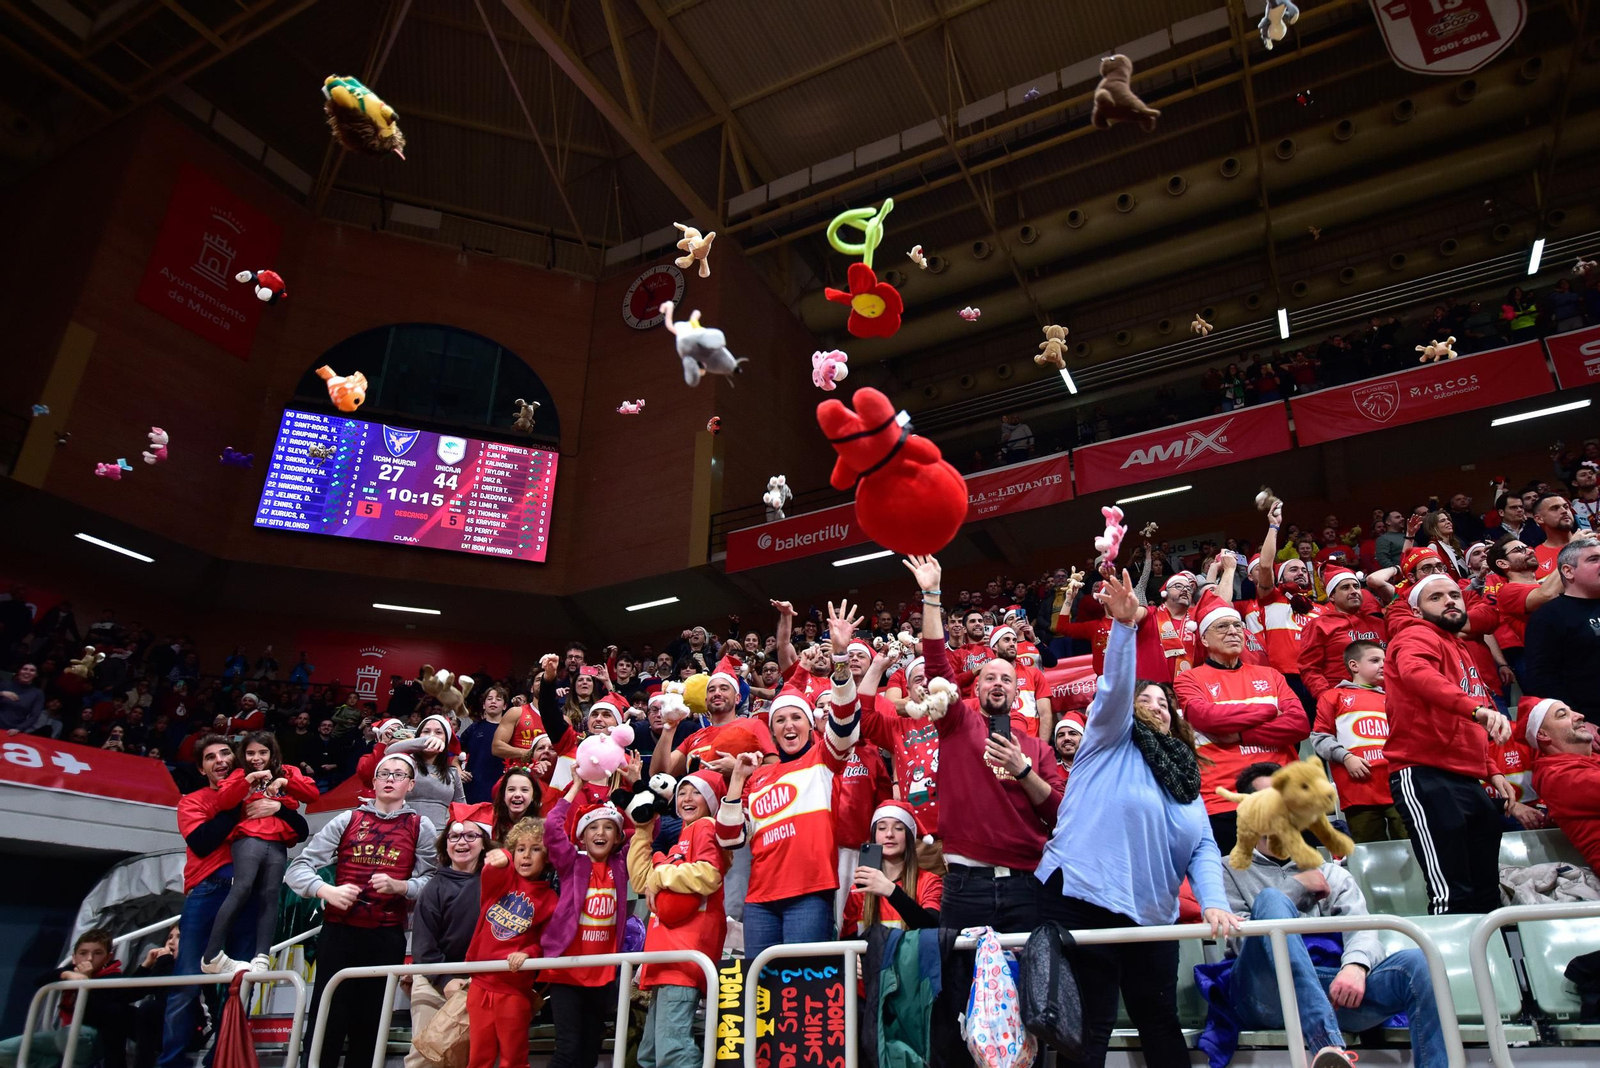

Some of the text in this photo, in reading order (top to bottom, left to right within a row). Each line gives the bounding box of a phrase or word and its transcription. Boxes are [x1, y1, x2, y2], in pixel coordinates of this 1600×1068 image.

[1433, 31, 1489, 55] 2001-2014
[159, 266, 246, 323] Ayuntamiento
[168, 290, 231, 330] de Murcia
[1356, 384, 1394, 396] PEUGEOT
[1409, 374, 1479, 398] MARCOS
[1119, 417, 1235, 470] AMIX
[372, 454, 417, 468] UCAM MURCIA
[435, 464, 462, 474] UNICAJA
[378, 464, 405, 482] 27
[433, 473, 458, 491] 44
[998, 474, 1063, 497] LEVANTE
[386, 487, 444, 507] 10:15
[364, 504, 373, 514] 5
[394, 509, 429, 520] DESCANSO
[449, 516, 458, 526] 5
[775, 523, 850, 551] bakertilly
[1408, 553, 1419, 563] DEL
[1358, 718, 1390, 736] UCAM
[1362, 750, 1384, 762] MUR
[755, 785, 790, 816] UCAM
[762, 822, 796, 847] MURCIA
[352, 844, 402, 860] UCAM
[351, 856, 396, 867] UNIVERSIDAD
[492, 903, 532, 928] TERCER
[587, 898, 615, 916] UCAM
[488, 910, 528, 934] CUARTO
[582, 929, 610, 942] MURCIA
[718, 958, 744, 1009] NOEL
[825, 982, 846, 1046] SHOES
